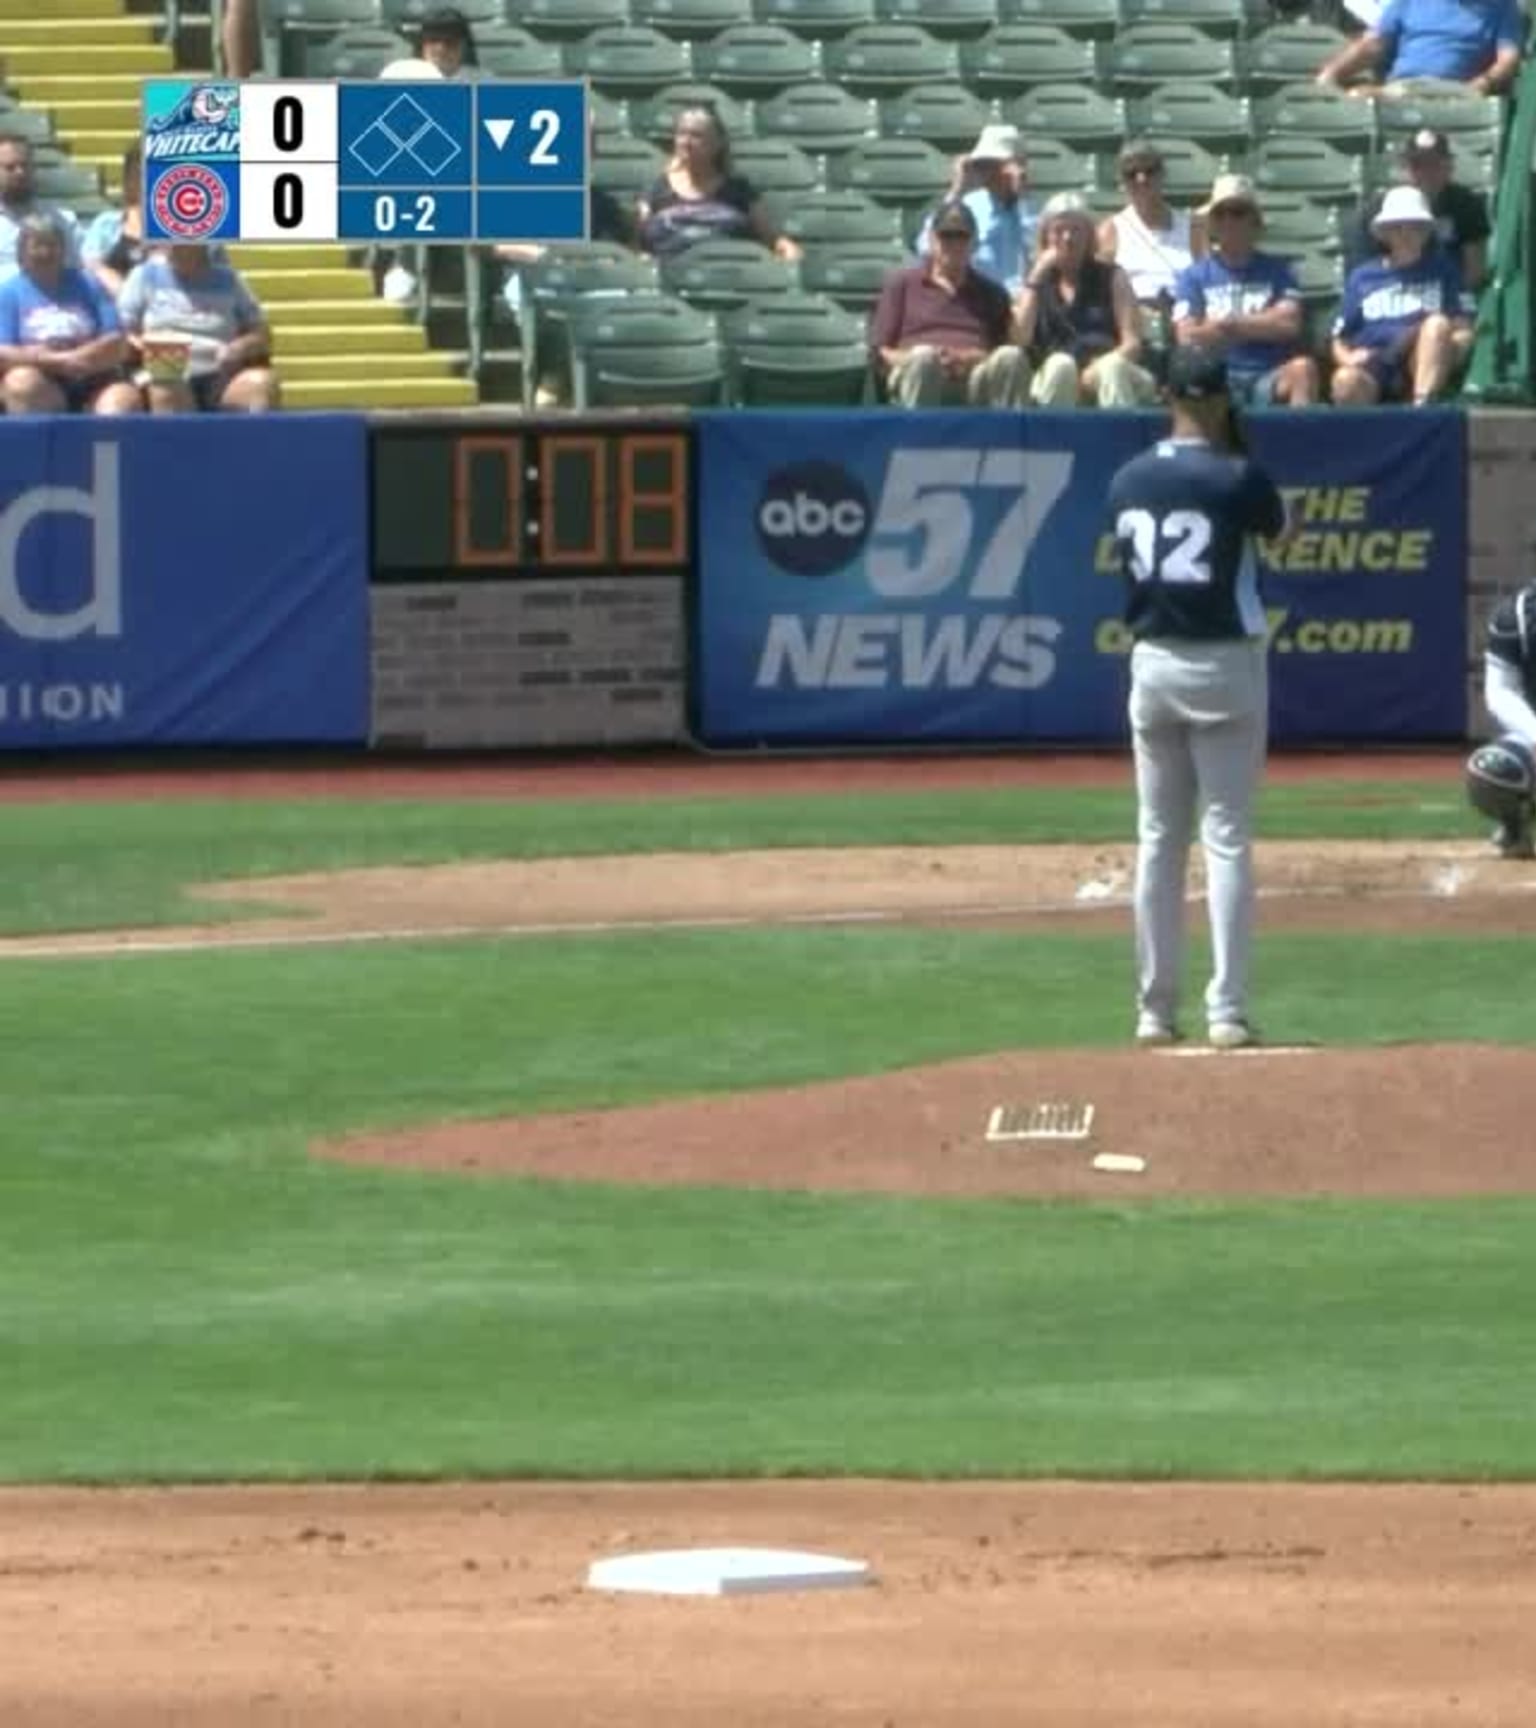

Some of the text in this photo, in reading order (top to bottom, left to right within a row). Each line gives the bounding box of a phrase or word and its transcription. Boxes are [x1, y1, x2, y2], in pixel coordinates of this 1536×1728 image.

[454, 435, 688, 567] 0:08
[759, 448, 1075, 597] abc 57
[755, 614, 1063, 688] NEWS
[1094, 606, 1414, 654] a7.com
[0, 683, 123, 720] ION
